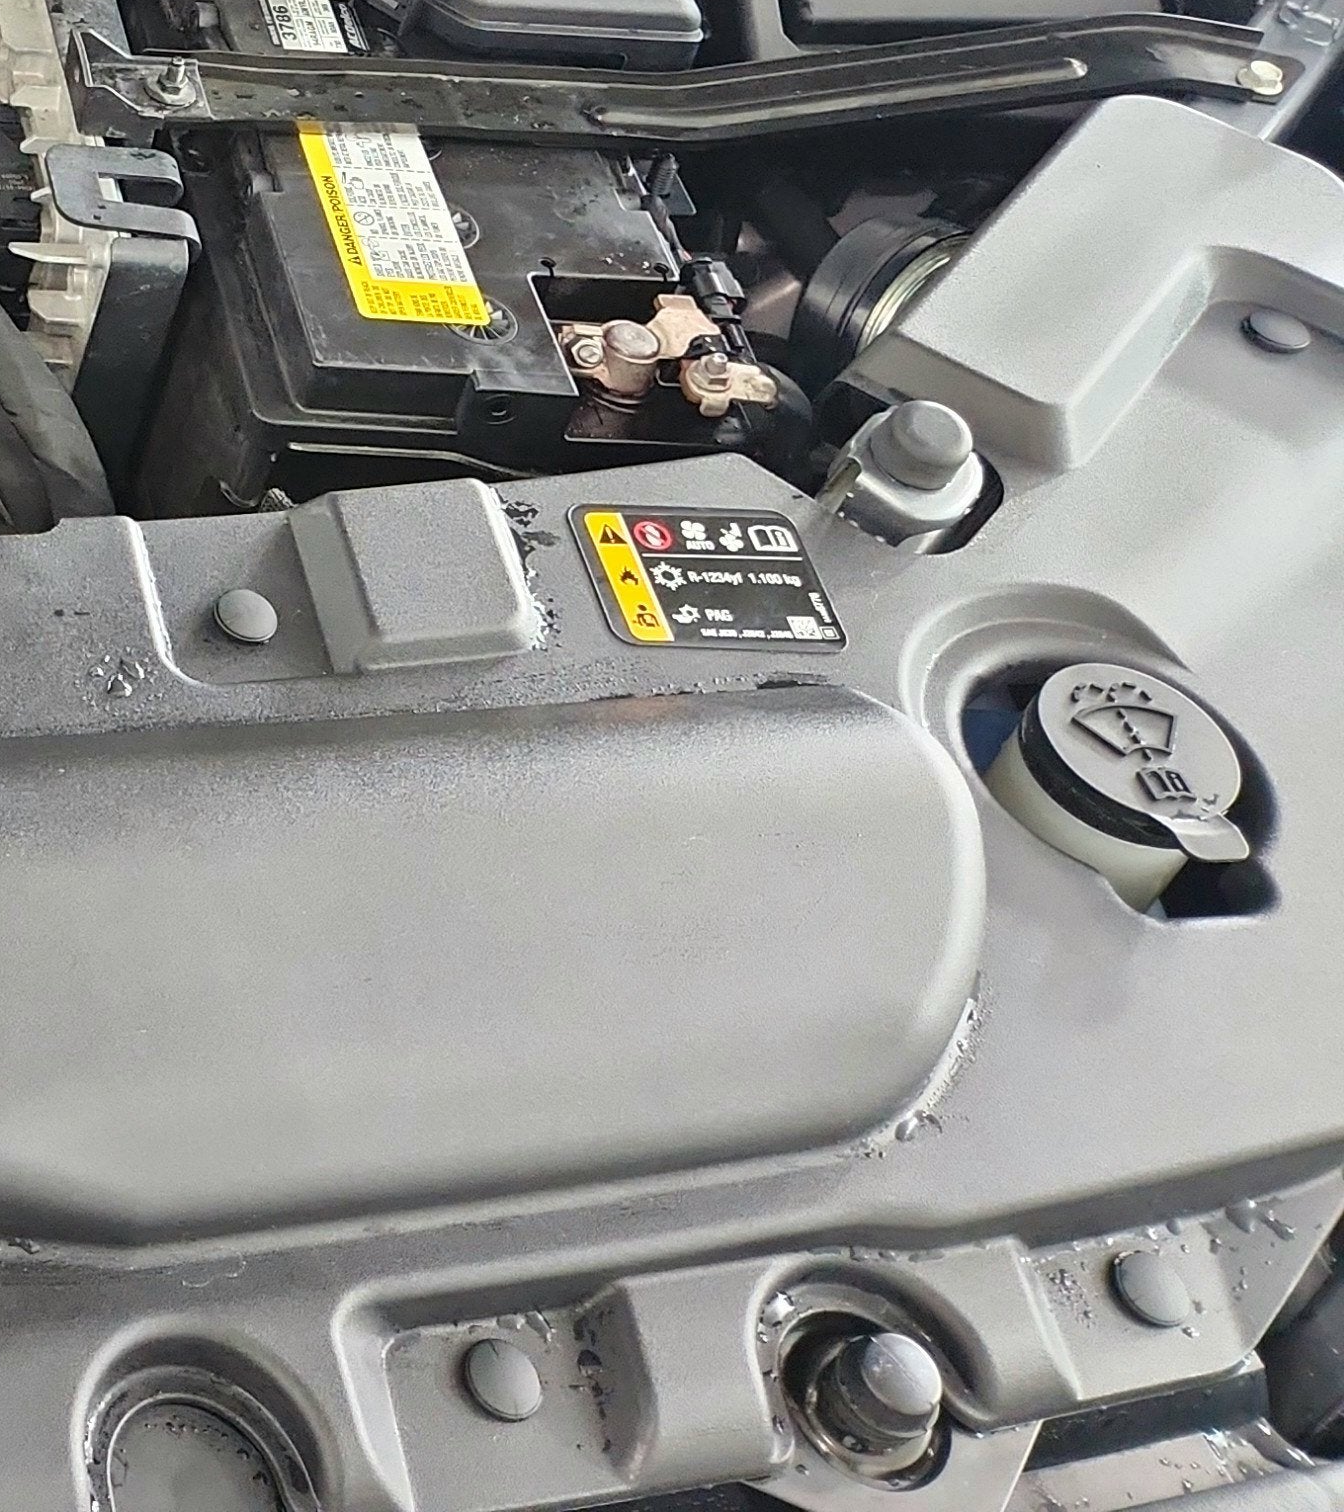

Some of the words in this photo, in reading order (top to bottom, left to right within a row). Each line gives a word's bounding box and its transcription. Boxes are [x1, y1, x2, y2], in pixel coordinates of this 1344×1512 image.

[272, 5, 297, 41] 3786
[322, 175, 344, 212] POISON
[335, 211, 363, 259] DANGER
[685, 540, 715, 551] AUTO
[705, 608, 734, 622] PAG
